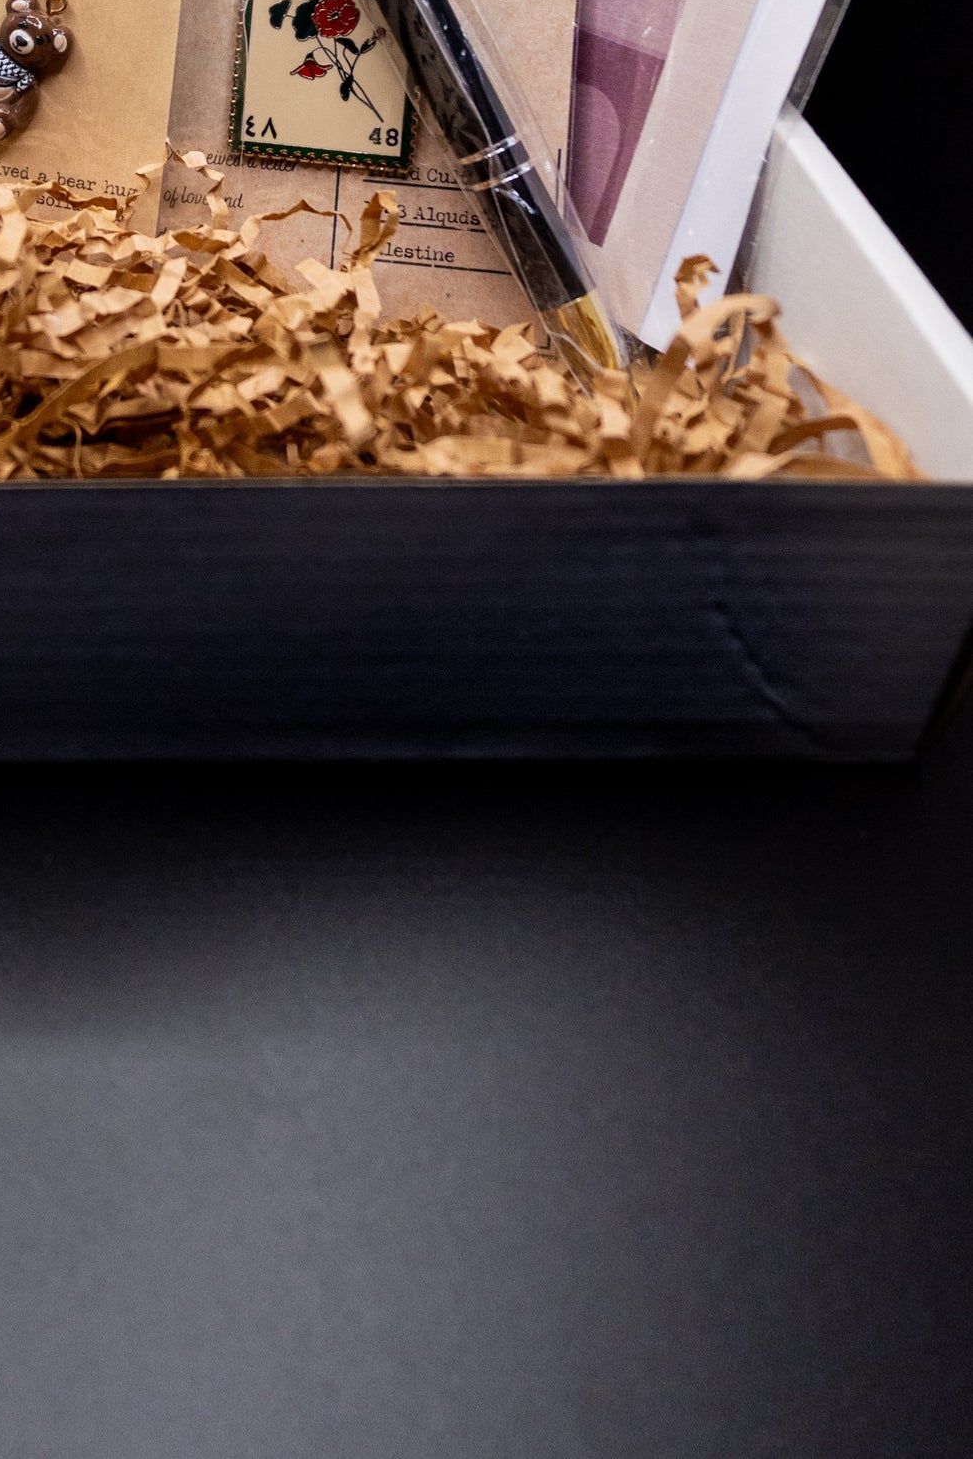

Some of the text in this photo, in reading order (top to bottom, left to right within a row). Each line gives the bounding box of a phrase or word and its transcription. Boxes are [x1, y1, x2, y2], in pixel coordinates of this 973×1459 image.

[369, 127, 399, 147] 48
[38, 172, 49, 183] a
[56, 171, 97, 192] bear
[163, 186, 178, 208] of
[413, 206, 481, 228] Alquds
[379, 242, 455, 263] lestine
